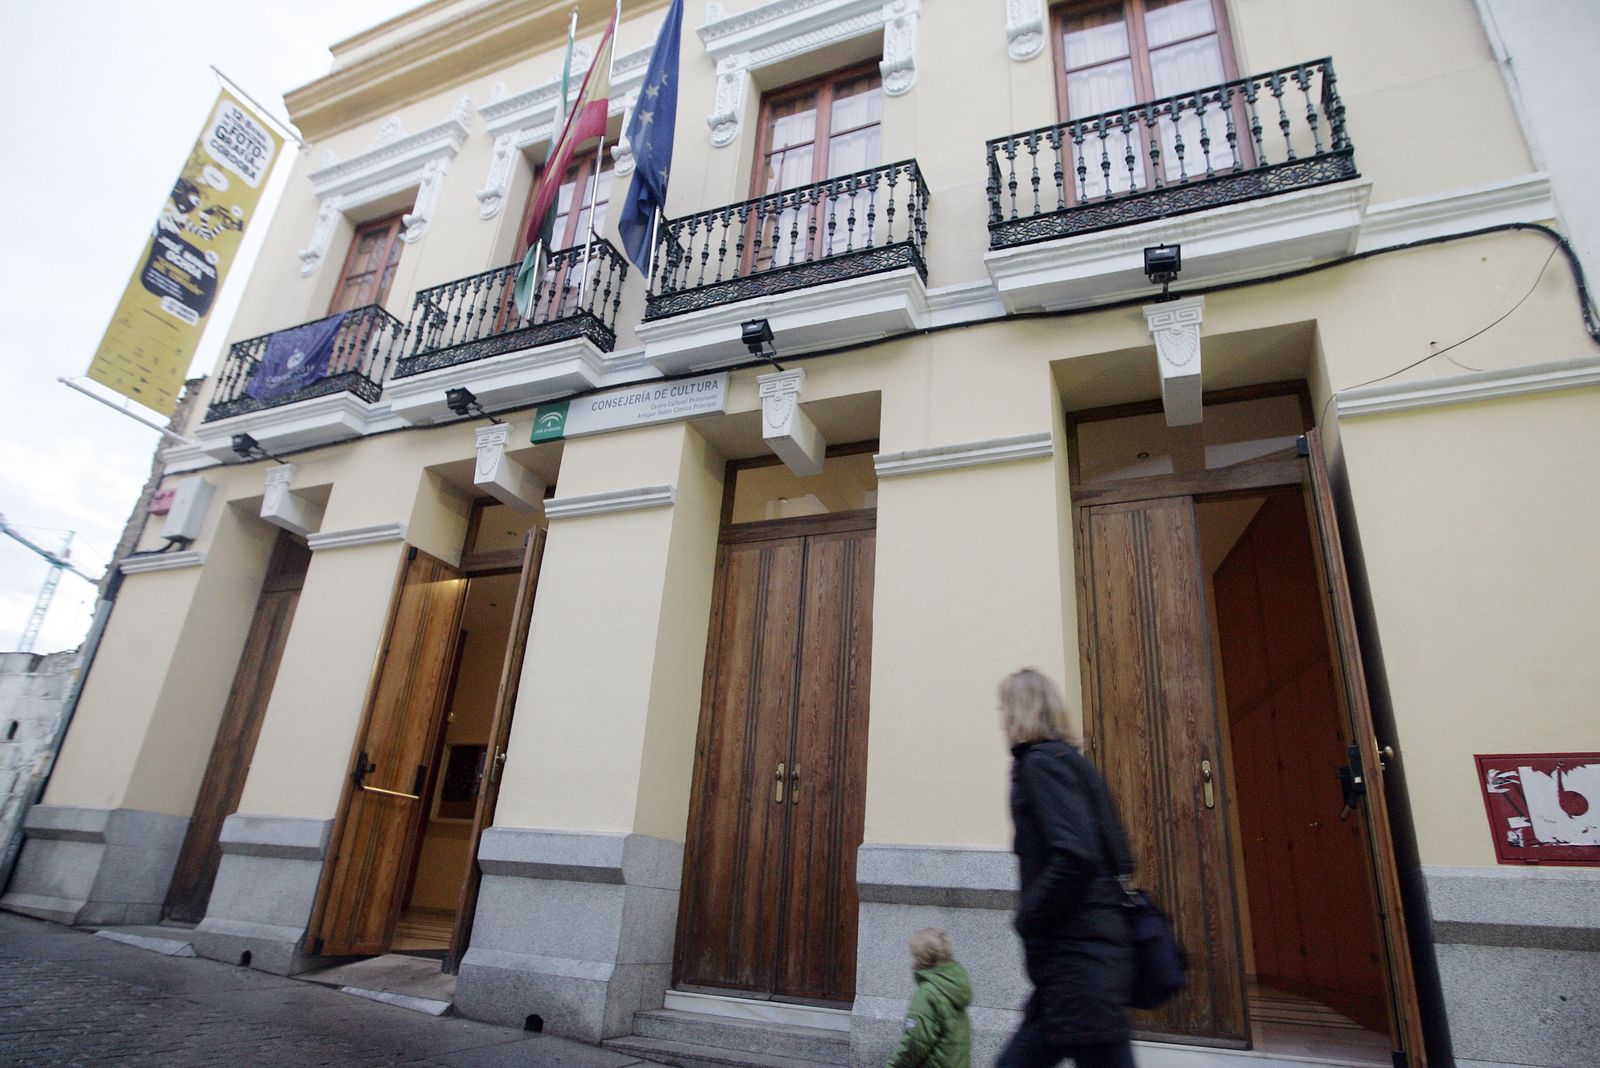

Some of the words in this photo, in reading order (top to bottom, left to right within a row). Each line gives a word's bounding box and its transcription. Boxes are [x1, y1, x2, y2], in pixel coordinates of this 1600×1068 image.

[592, 391, 651, 412] CONSEJERÍA
[654, 388, 668, 400] DE
[670, 380, 719, 397] CULTURA
